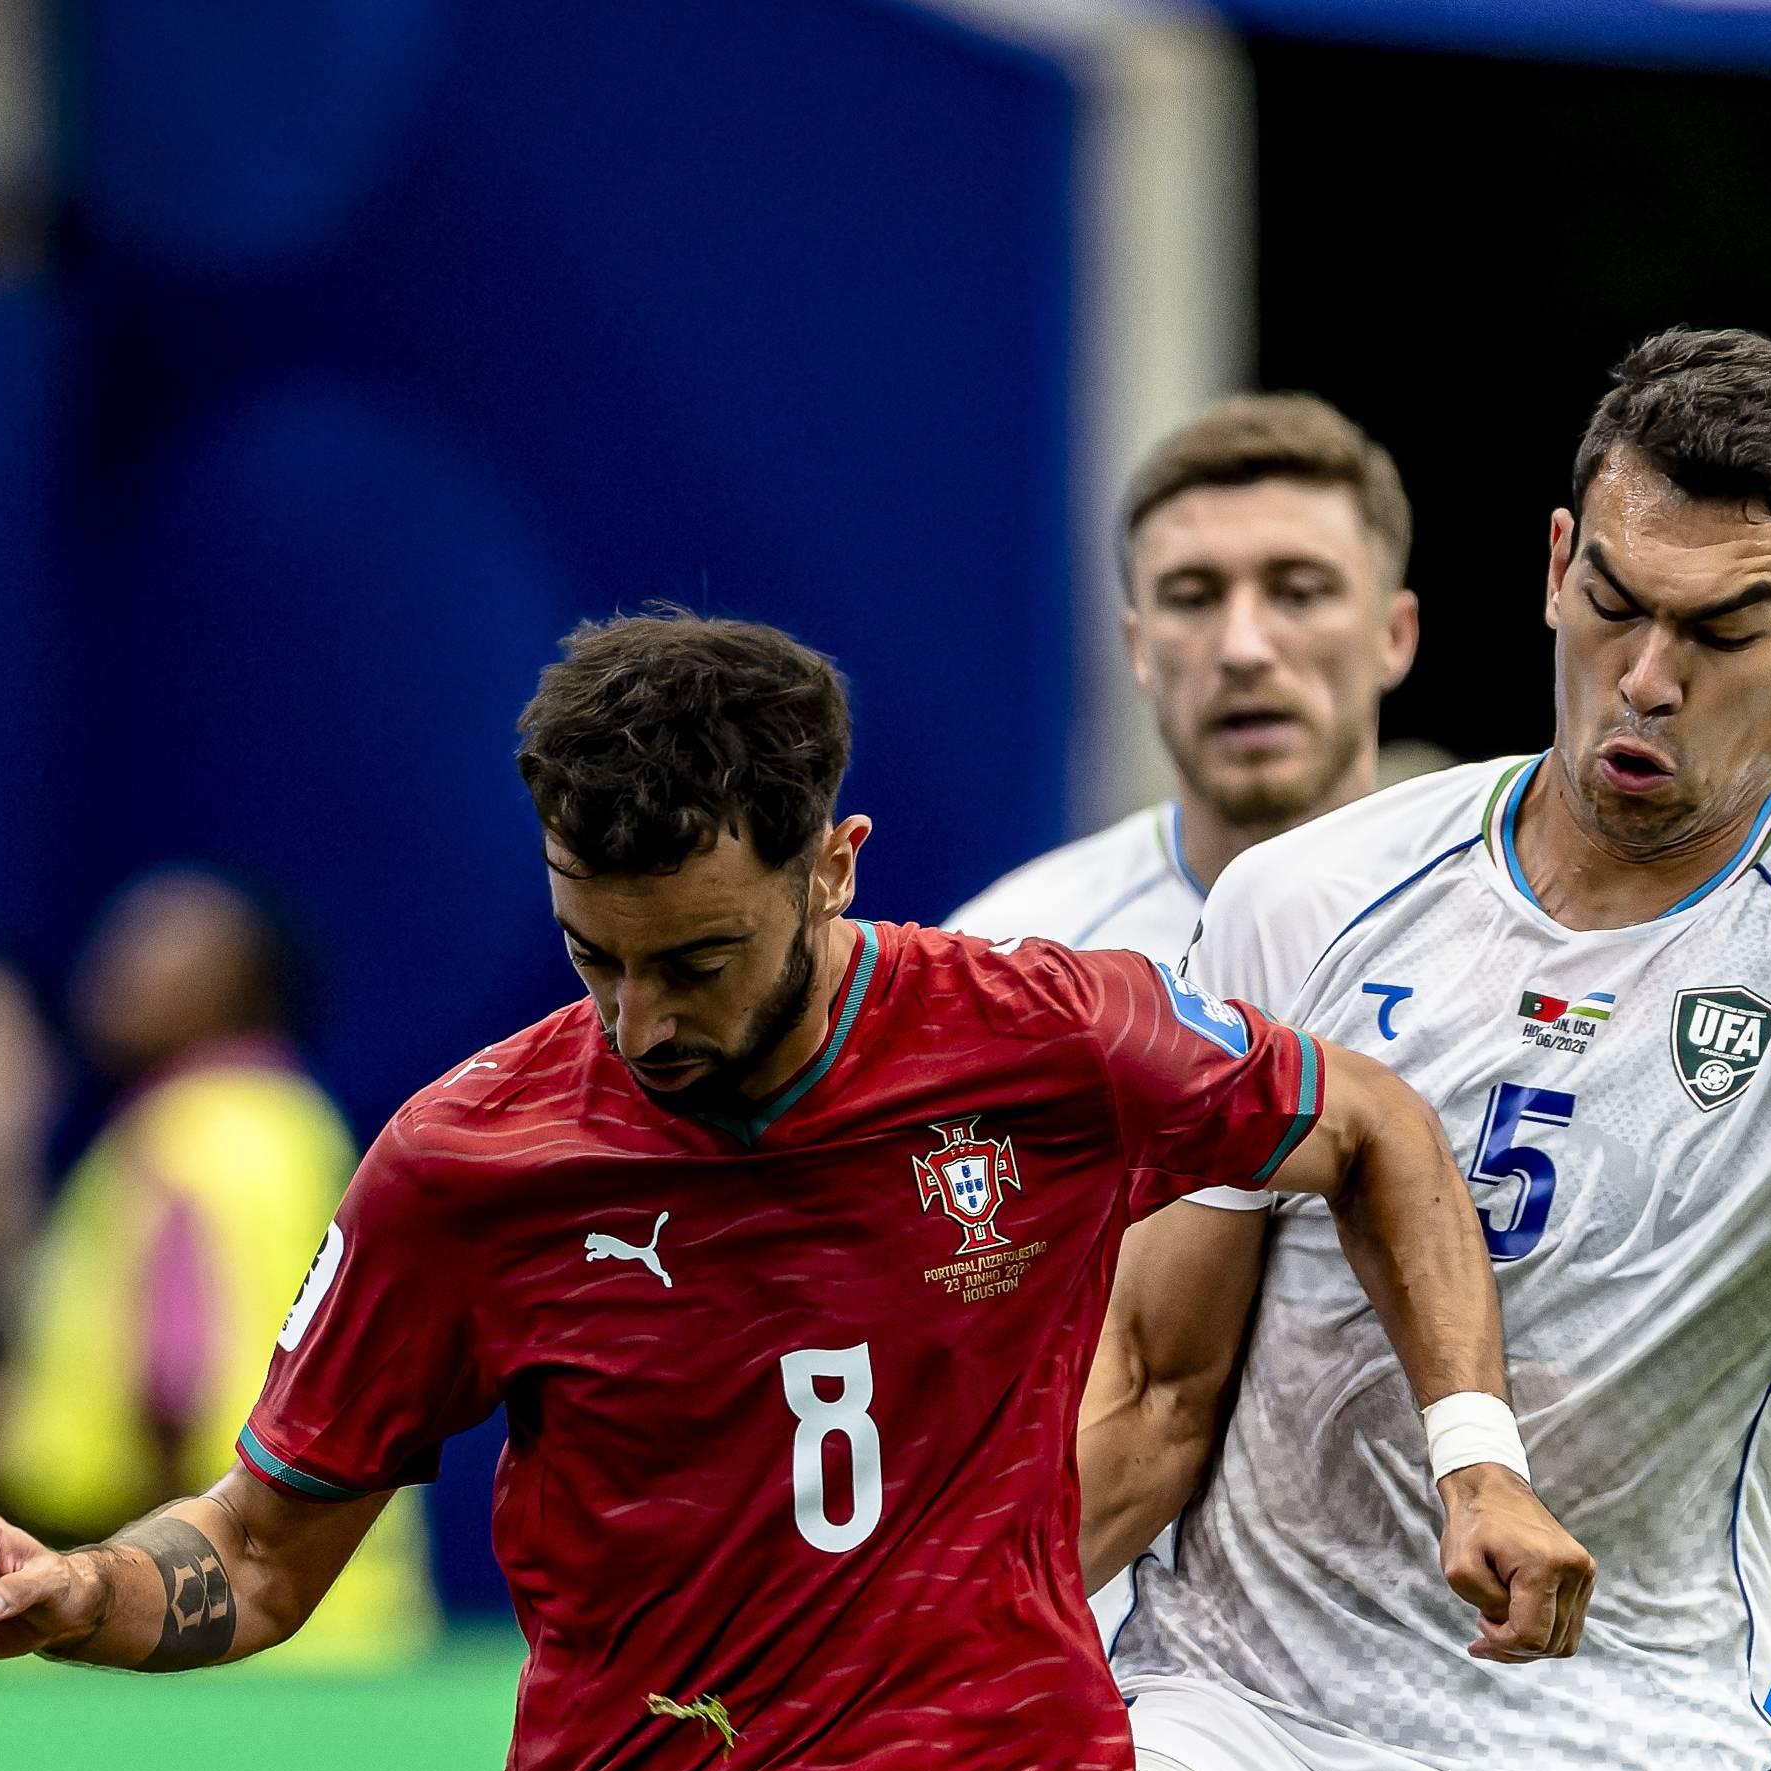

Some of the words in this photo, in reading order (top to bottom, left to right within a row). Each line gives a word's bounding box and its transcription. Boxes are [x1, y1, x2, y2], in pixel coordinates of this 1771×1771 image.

[1573, 1019, 1597, 1038] USA
[1688, 1004, 1762, 1057] UFA
[1468, 1082, 1576, 1262] 5
[943, 1278, 961, 1293] 23
[964, 1269, 1001, 1289] JUNHO
[962, 1277, 1019, 1304] HOUSTON
[780, 1341, 883, 1554] 8
